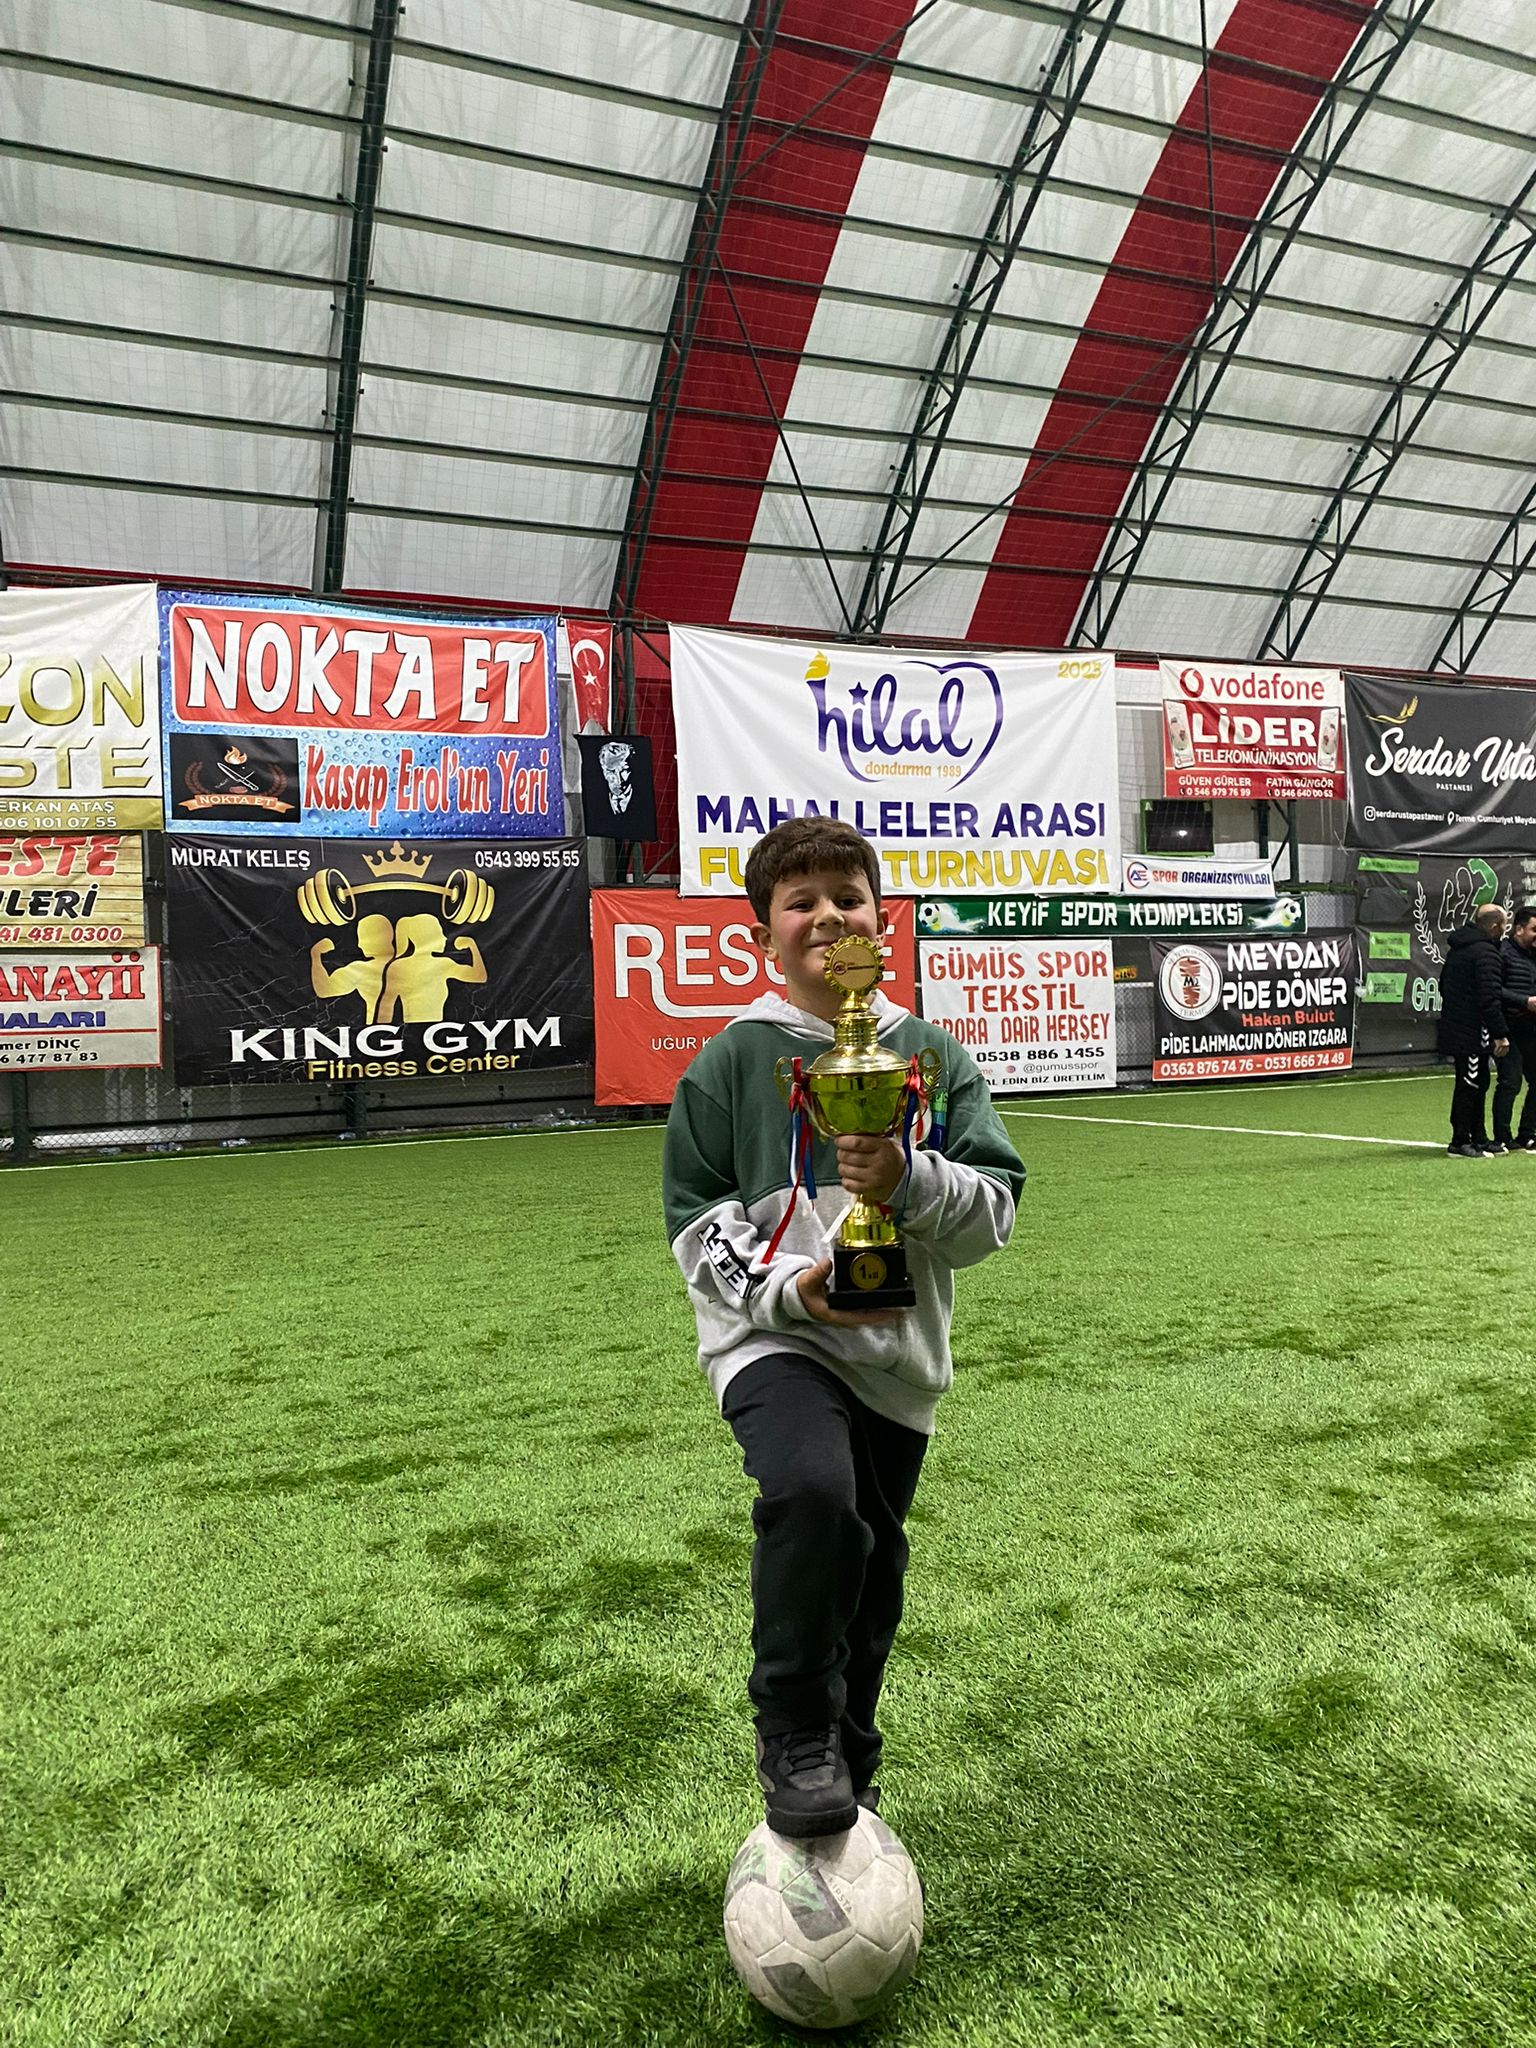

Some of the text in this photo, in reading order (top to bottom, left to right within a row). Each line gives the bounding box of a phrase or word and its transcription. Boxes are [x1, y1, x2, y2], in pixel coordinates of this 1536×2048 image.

[185, 617, 536, 722] NOKTA ET
[0, 654, 145, 727] ON
[1210, 672, 1325, 700] vodafone
[805, 670, 972, 762] hilal
[1192, 707, 1318, 747] LİDER
[1195, 748, 1317, 767] TELEKOMÜNİKASYON
[1365, 727, 1471, 777] Serdar
[865, 759, 962, 778] dondurma 1989
[1178, 775, 1251, 786] GÜVEN GÜRLER
[304, 745, 549, 827] Kasap Erol'un Yeri
[1293, 777, 1334, 788] GÜNGÖR
[1436, 782, 1473, 792] PASTANESİ
[68, 801, 115, 815] ATAŞ
[200, 795, 274, 806] NOKTA ET
[34, 817, 62, 828] 101
[67, 817, 90, 828] 07
[95, 816, 117, 828] 55
[992, 802, 1105, 837] ARASI
[171, 847, 311, 870] MURAT KELEŞ
[474, 850, 580, 869] 0543 399 55 55
[883, 850, 1110, 888] TURNUVASI
[1152, 869, 1271, 885] SPOR ORGANİZASYONLARI
[0, 884, 98, 919] LERİ
[1061, 902, 1118, 927] SPOR
[28, 927, 63, 942] 481
[70, 927, 122, 942] 0300
[1038, 950, 1108, 978] SPOR
[1227, 940, 1341, 972] MEYDAN
[963, 983, 1085, 1013] TEKSTİL
[1222, 971, 1347, 1011] PİDE DÖNER
[0, 1011, 106, 1029] ALARI
[931, 1016, 989, 1044] PORA
[1047, 1013, 1110, 1042] HERŞEY
[1242, 1009, 1335, 1027] Hakan Bulut
[37, 1037, 80, 1051] DİNÇ
[229, 1016, 567, 1062] KING GYM
[652, 1034, 697, 1051] UĞUR
[1161, 1027, 1348, 1055] PİDE LAHMACUN DÖNER IZGARA
[16, 1054, 47, 1064] 477
[53, 1053, 73, 1063] 87
[79, 1052, 98, 1062] 83
[307, 1053, 520, 1080] Fitness Center
[976, 1047, 1105, 1063] 0538 886 1455
[1160, 1062, 1195, 1076] 0362
[1197, 1060, 1221, 1074] 876
[1222, 1059, 1237, 1073] 74
[1239, 1058, 1254, 1072] 76
[1264, 1057, 1291, 1070] 0531
[1293, 1055, 1315, 1069] 666
[1317, 1053, 1330, 1067] 74
[1331, 1052, 1345, 1066] 49
[1002, 1076, 1028, 1085] EDİN
[1031, 1075, 1050, 1084] BİZ
[1053, 1073, 1106, 1083] ÜRETELİM
